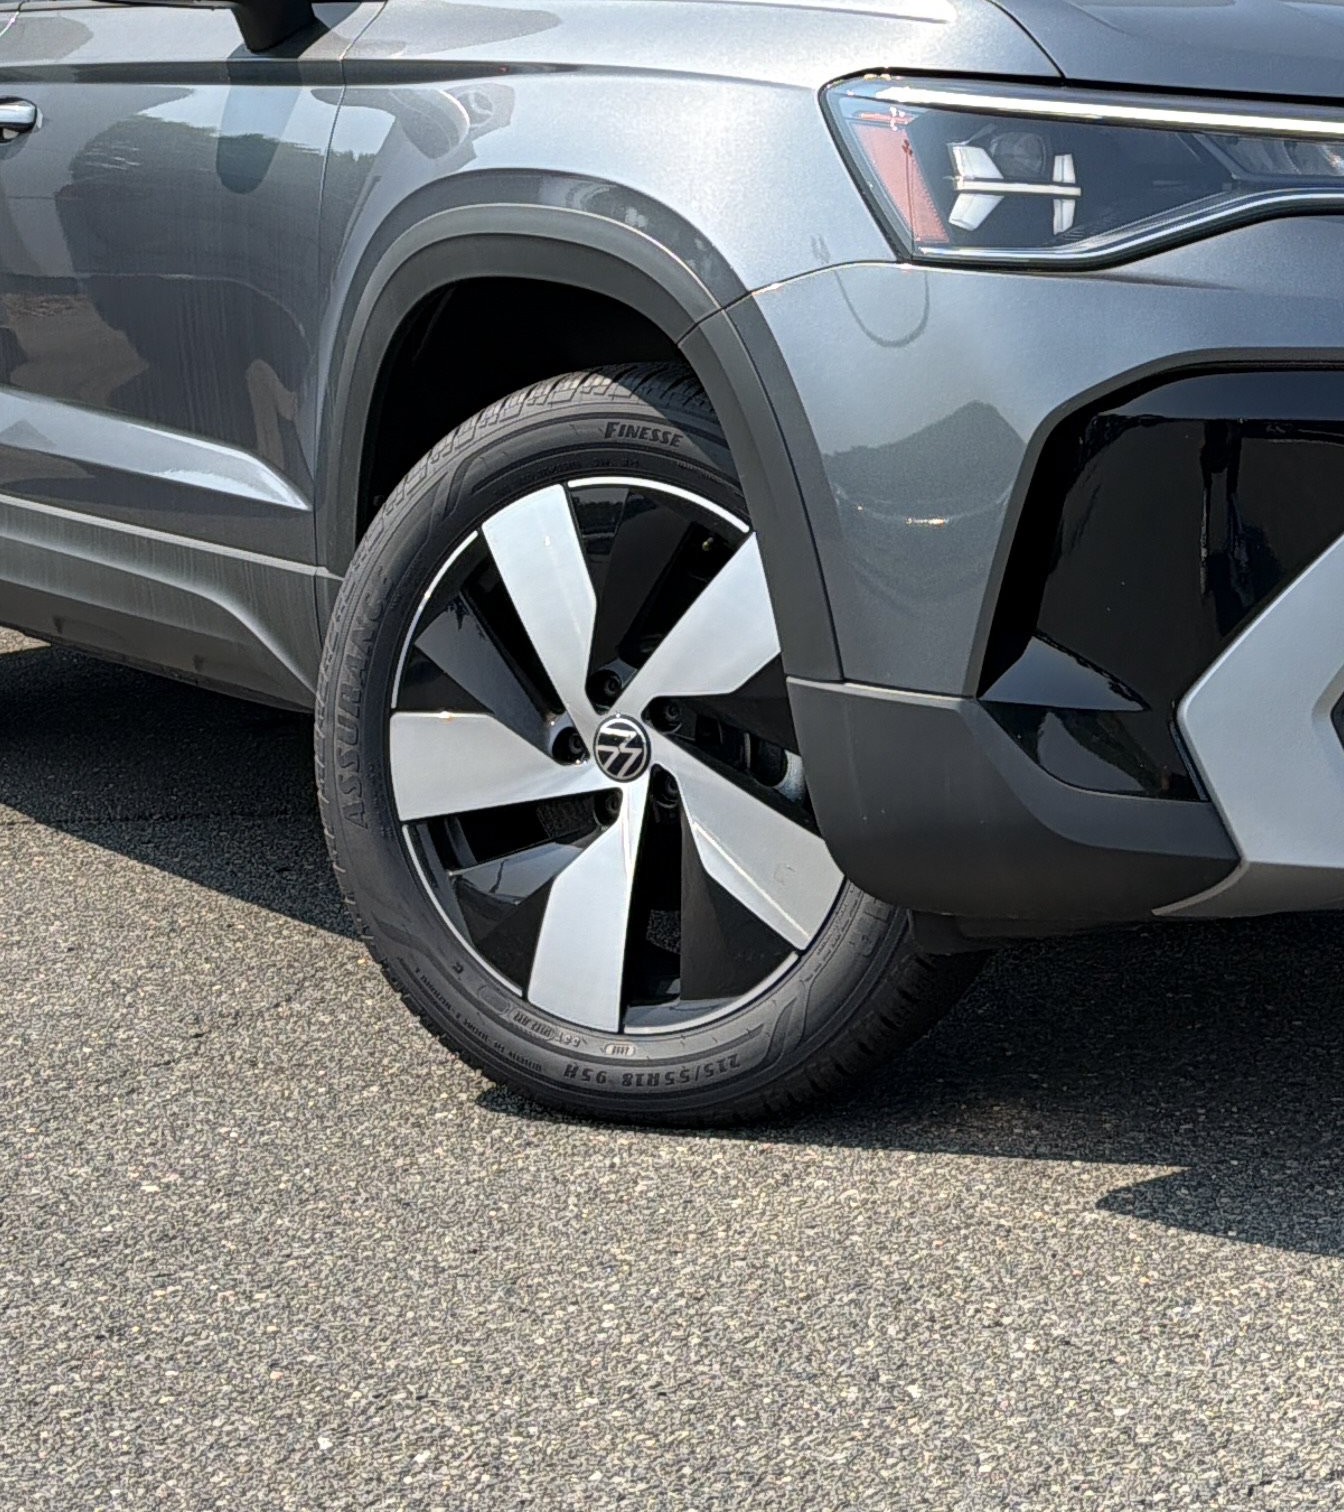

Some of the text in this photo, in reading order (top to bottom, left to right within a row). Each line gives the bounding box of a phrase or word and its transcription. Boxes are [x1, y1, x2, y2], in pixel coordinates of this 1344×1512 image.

[604, 420, 684, 448] FINESSE
[595, 717, 649, 780] VW
[621, 1053, 741, 1087] 215/55R18
